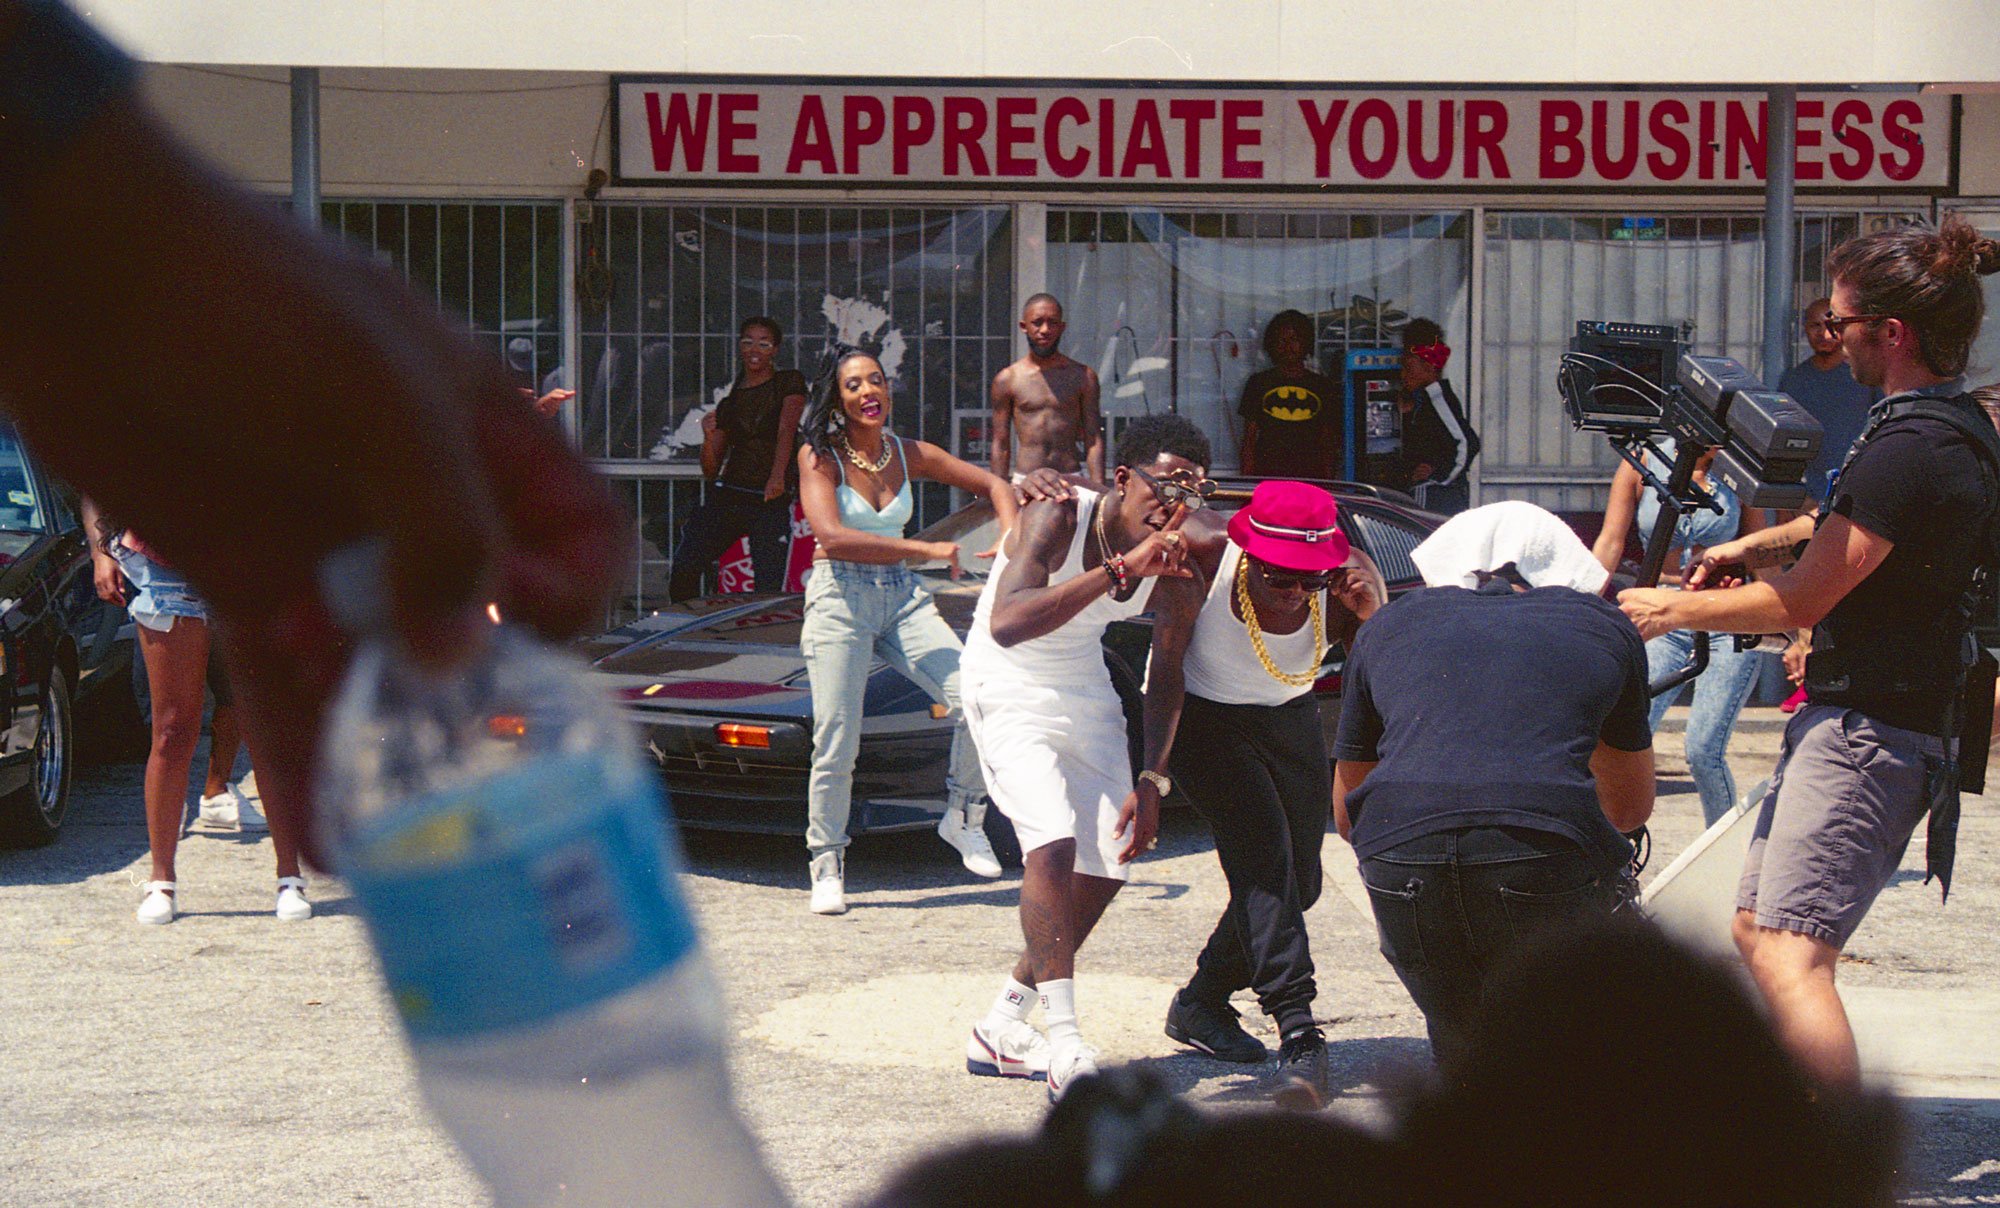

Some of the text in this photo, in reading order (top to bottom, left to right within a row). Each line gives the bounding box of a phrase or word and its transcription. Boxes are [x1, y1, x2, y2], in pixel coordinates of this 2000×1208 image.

[645, 92, 1924, 181] WE APPRECIATE YOUR BUSINESS
